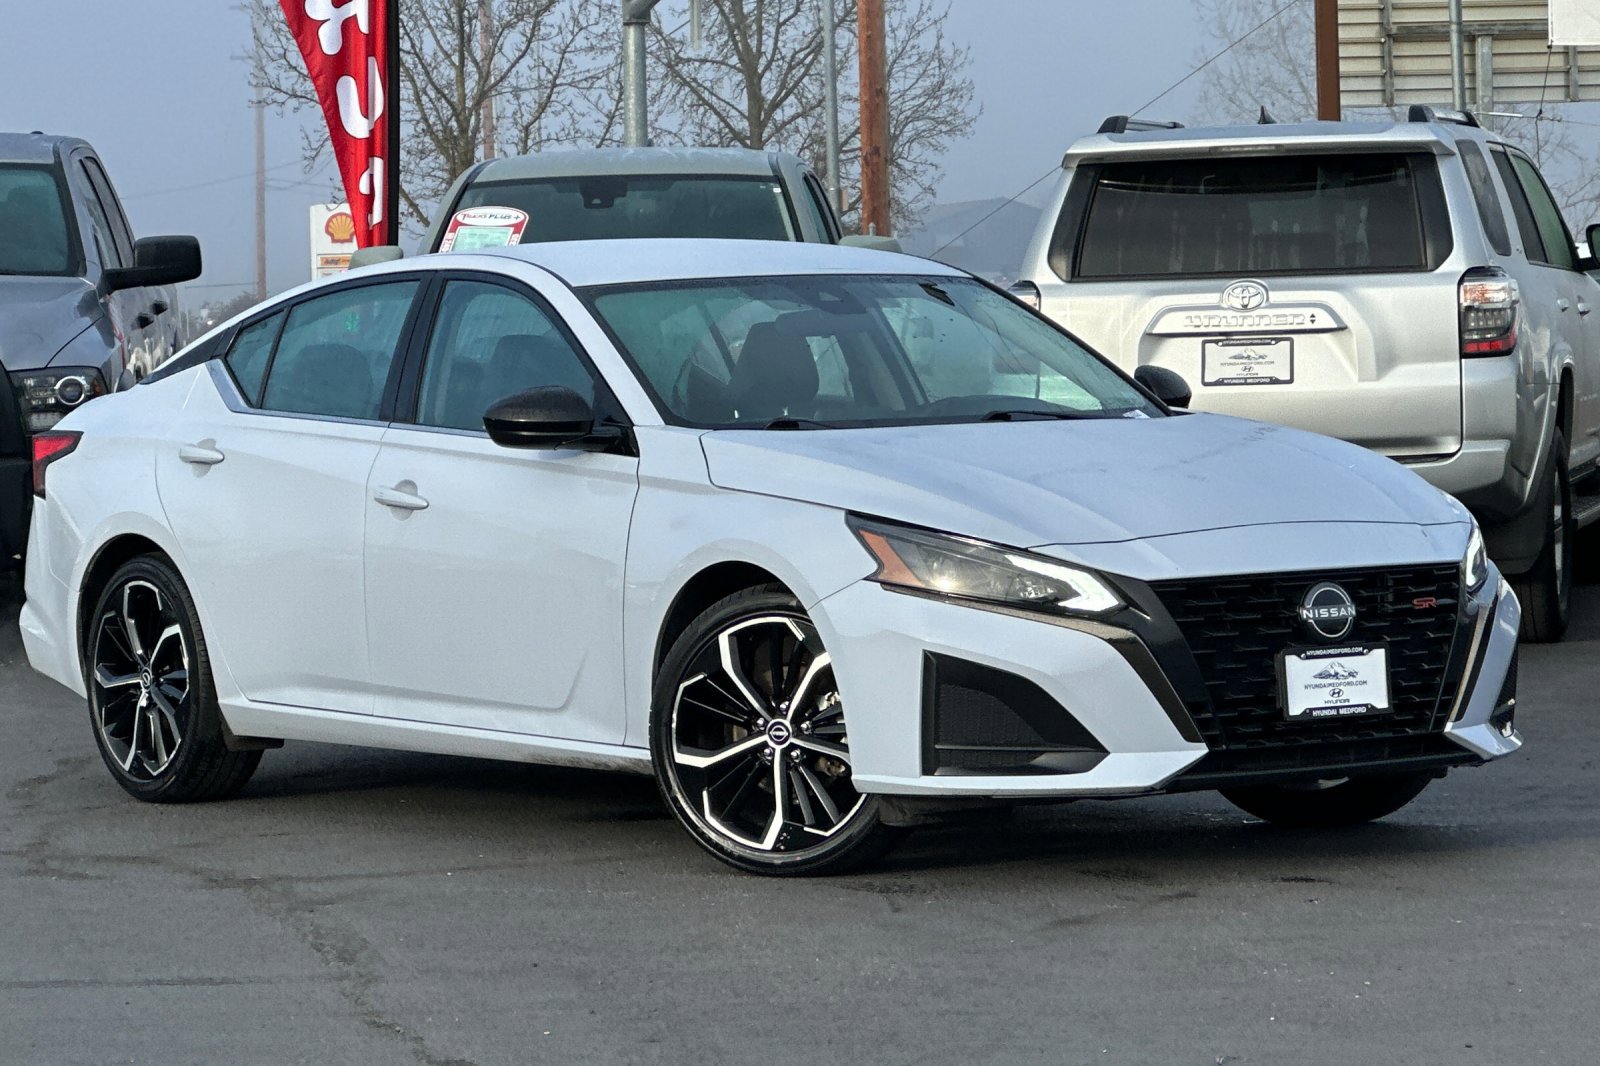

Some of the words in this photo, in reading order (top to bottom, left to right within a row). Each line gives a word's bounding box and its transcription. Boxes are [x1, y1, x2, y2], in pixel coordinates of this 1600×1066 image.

[1412, 597, 1437, 609] SR
[1302, 606, 1356, 619] NISSAN
[1306, 647, 1363, 656] HYUNDAIMEDFORD.COM
[1304, 679, 1368, 690] HYUNDAIMEDFORD.COM
[1312, 708, 1337, 717] HYUNDAI
[1339, 706, 1367, 715] MEDFORD
